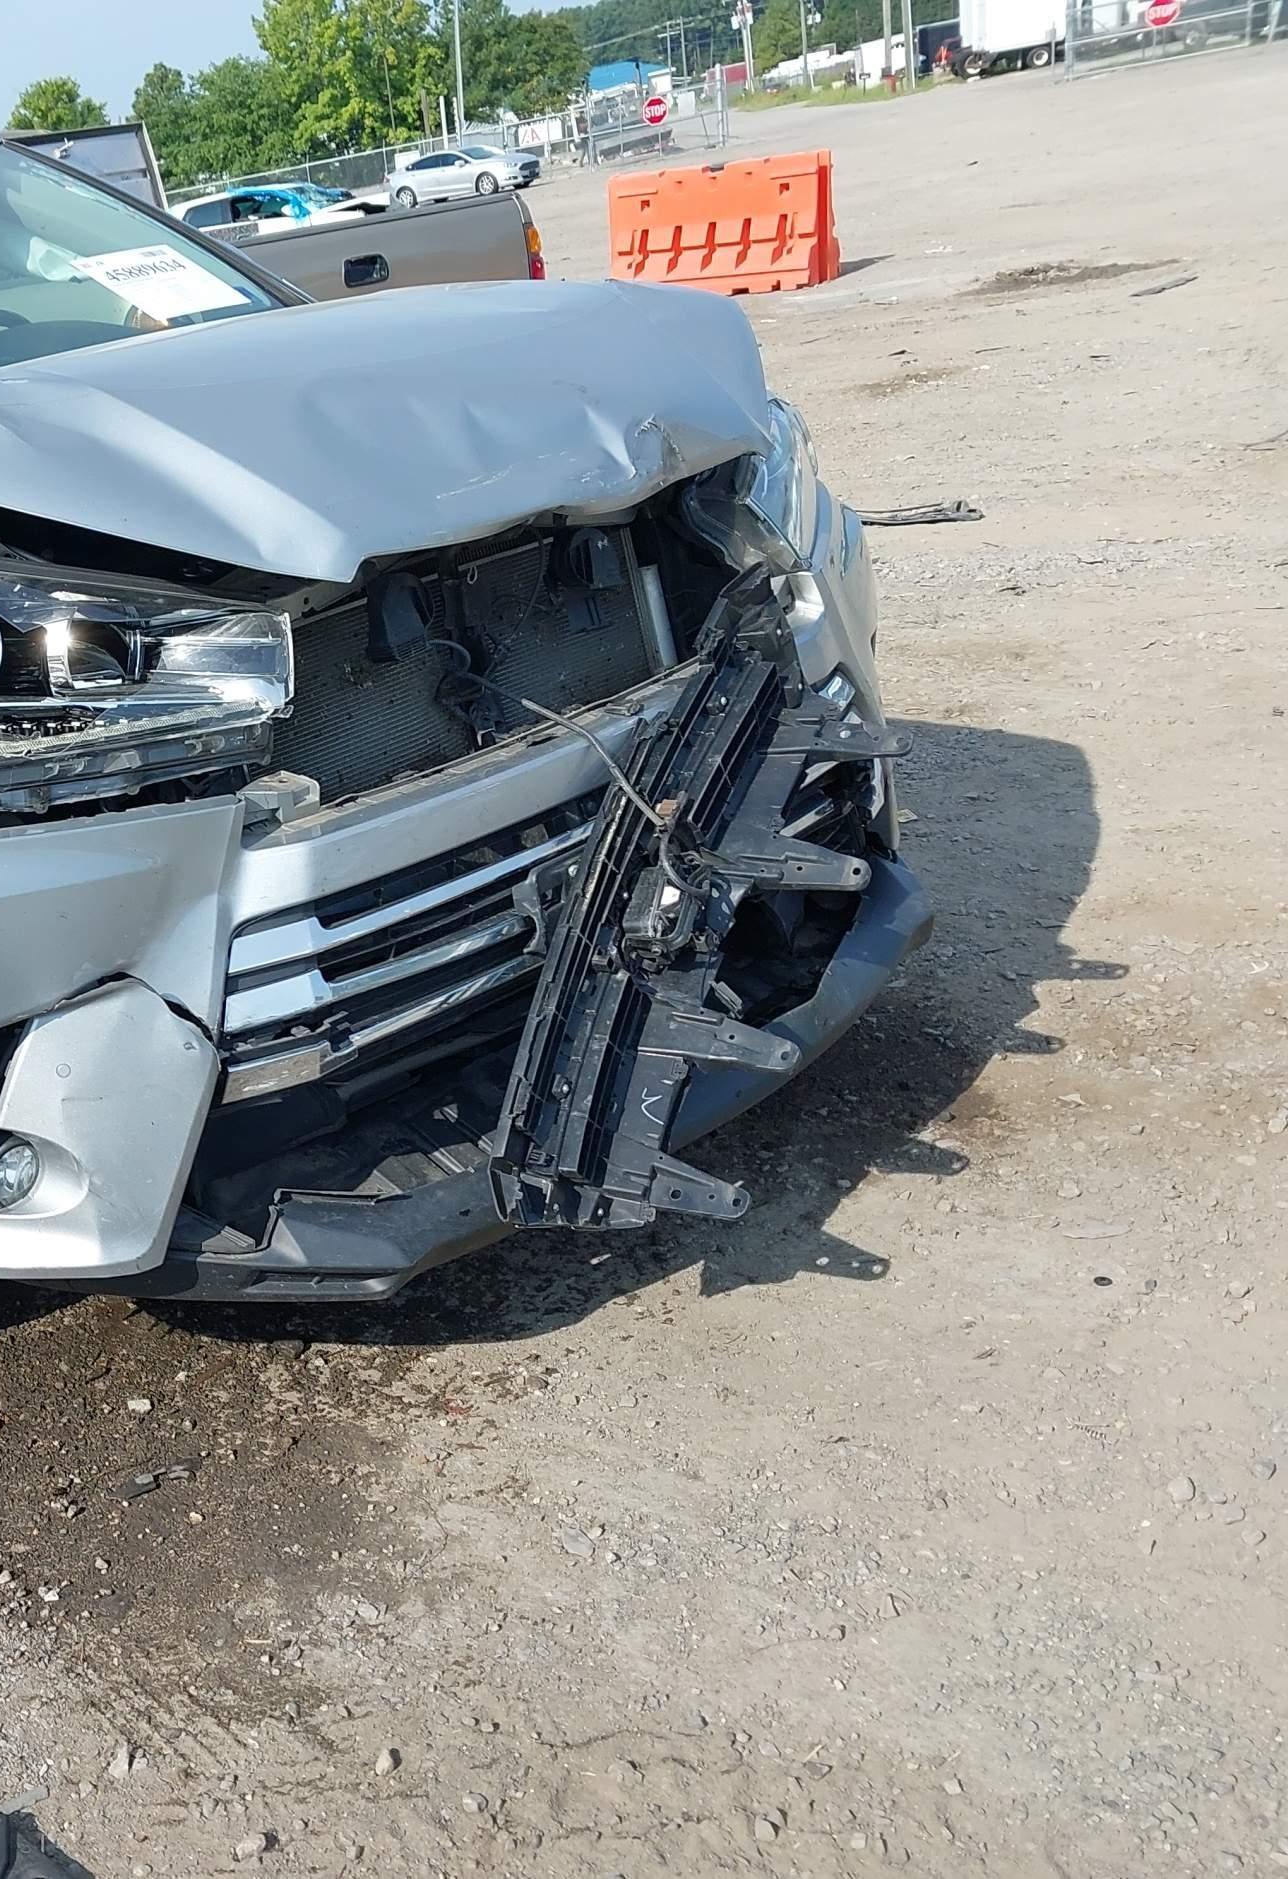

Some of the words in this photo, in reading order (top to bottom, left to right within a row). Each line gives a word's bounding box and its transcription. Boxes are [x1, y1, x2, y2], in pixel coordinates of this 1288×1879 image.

[1148, 2, 1178, 20] STOP
[645, 103, 667, 118] STOP
[104, 258, 187, 282] 45889634
